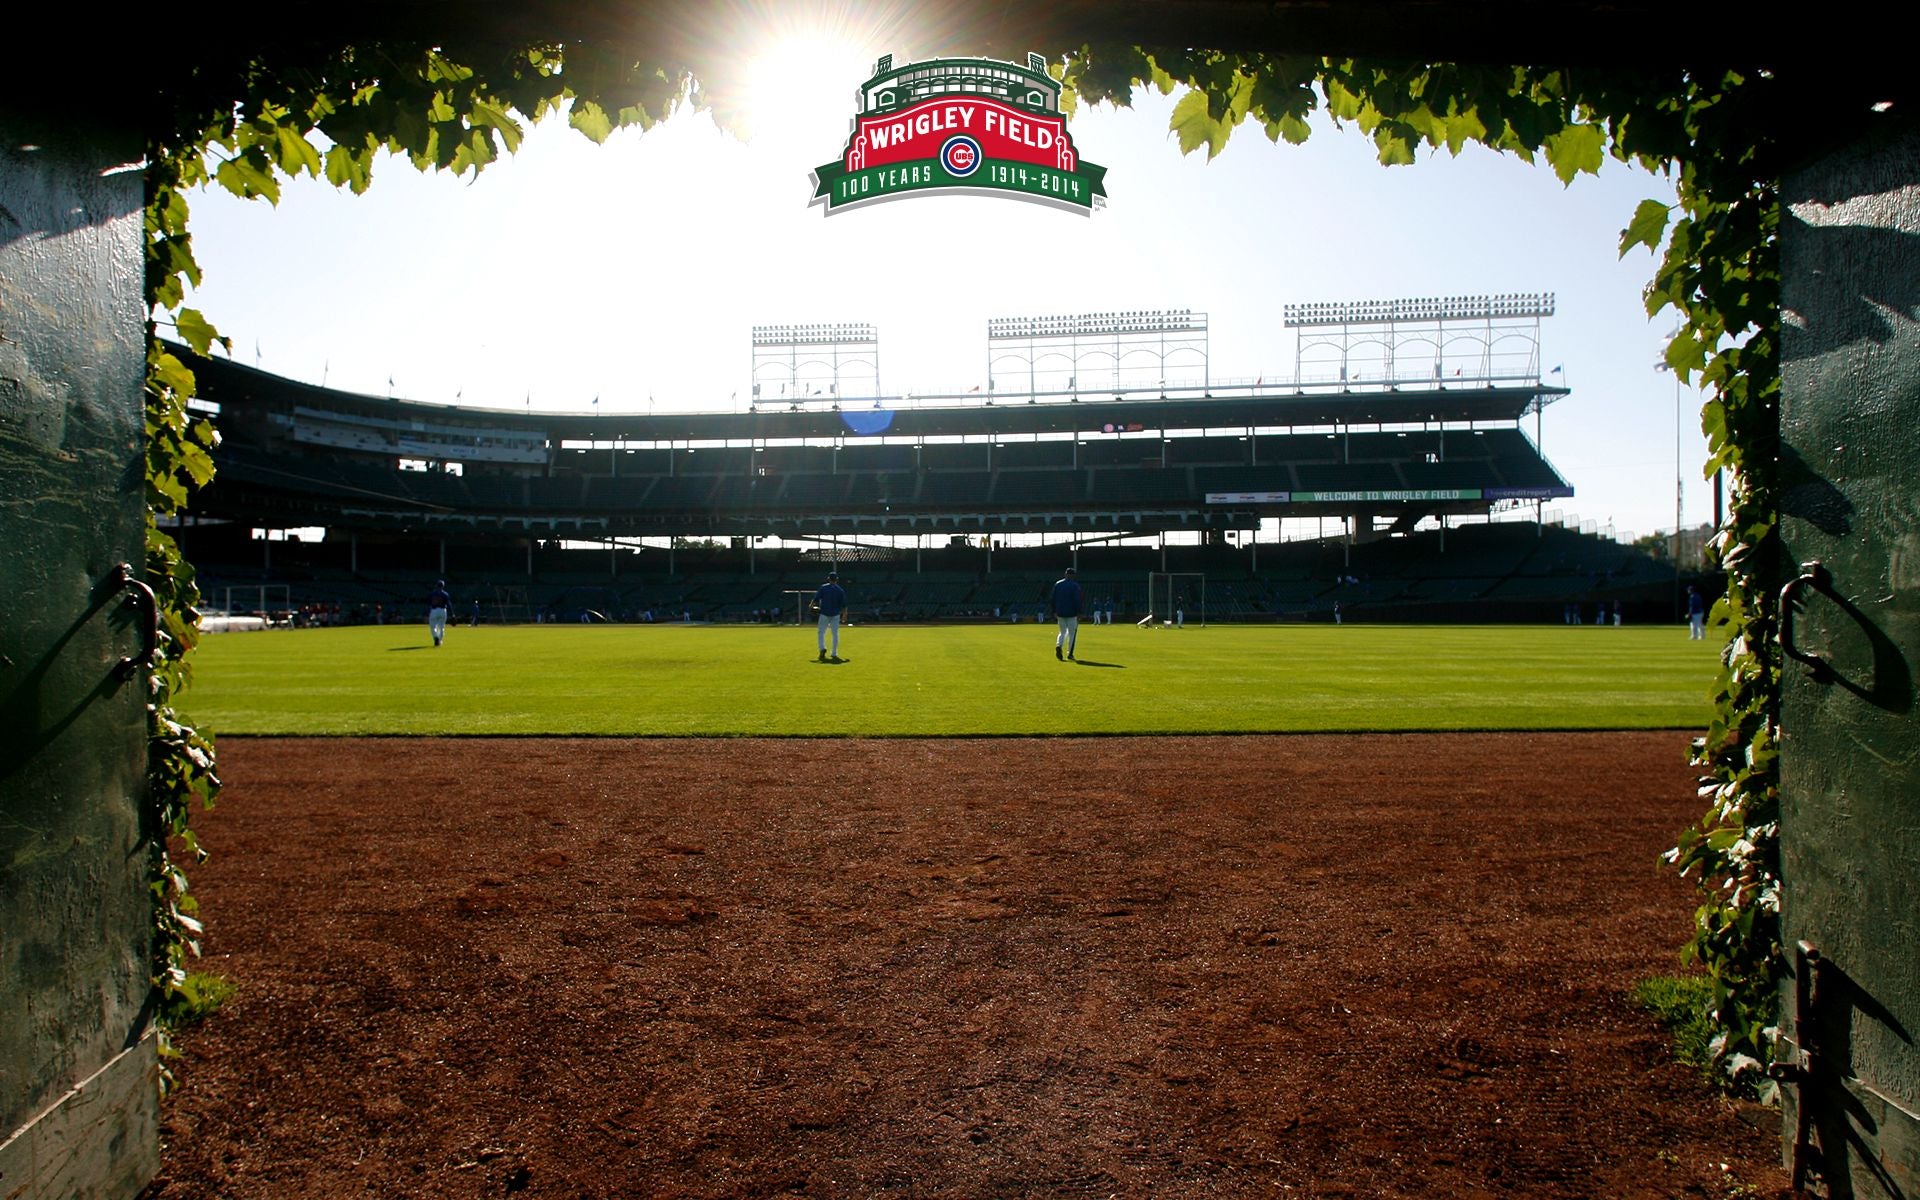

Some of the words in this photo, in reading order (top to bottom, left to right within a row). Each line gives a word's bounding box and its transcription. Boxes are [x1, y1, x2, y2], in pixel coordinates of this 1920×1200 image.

[1313, 491, 1362, 501] WELCOME
[1367, 491, 1379, 500] TO
[1382, 490, 1427, 500] WRIGLEY
[1431, 489, 1460, 499] FIELD
